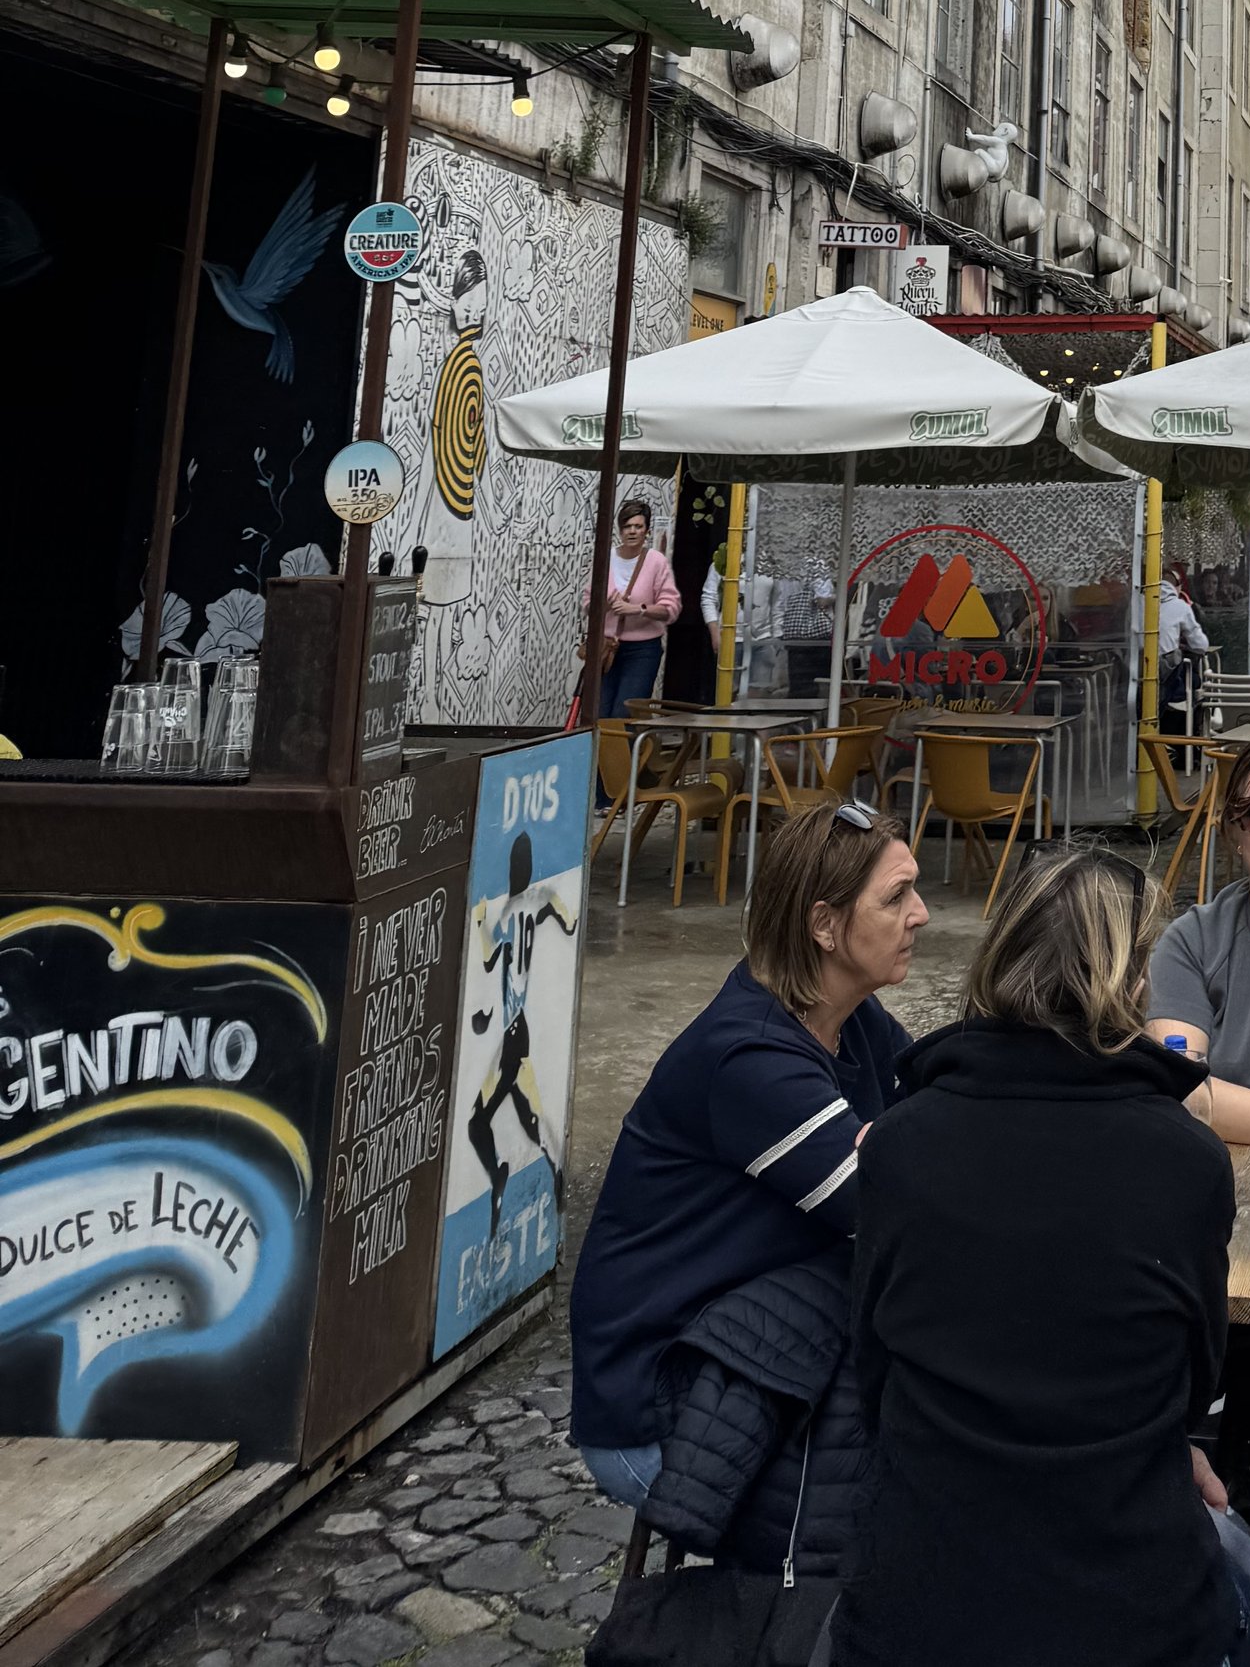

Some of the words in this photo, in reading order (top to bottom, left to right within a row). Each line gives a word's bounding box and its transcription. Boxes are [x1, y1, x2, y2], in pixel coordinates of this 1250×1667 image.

[349, 233, 419, 251] CREATURE
[823, 225, 898, 244] TATTOO
[351, 255, 399, 277] AMERICAN
[401, 254, 415, 269] IPA
[910, 409, 989, 440] SUMOL
[1152, 408, 1232, 437] SUMOL
[348, 468, 381, 488] IPA
[868, 650, 1007, 685] MICRO
[369, 887, 446, 985] NEVER
[518, 911, 536, 975] 10
[360, 968, 429, 1056] MADE
[0, 1209, 95, 1277] DULCE
[107, 1200, 137, 1235] DE
[151, 1171, 262, 1274] LECHE
